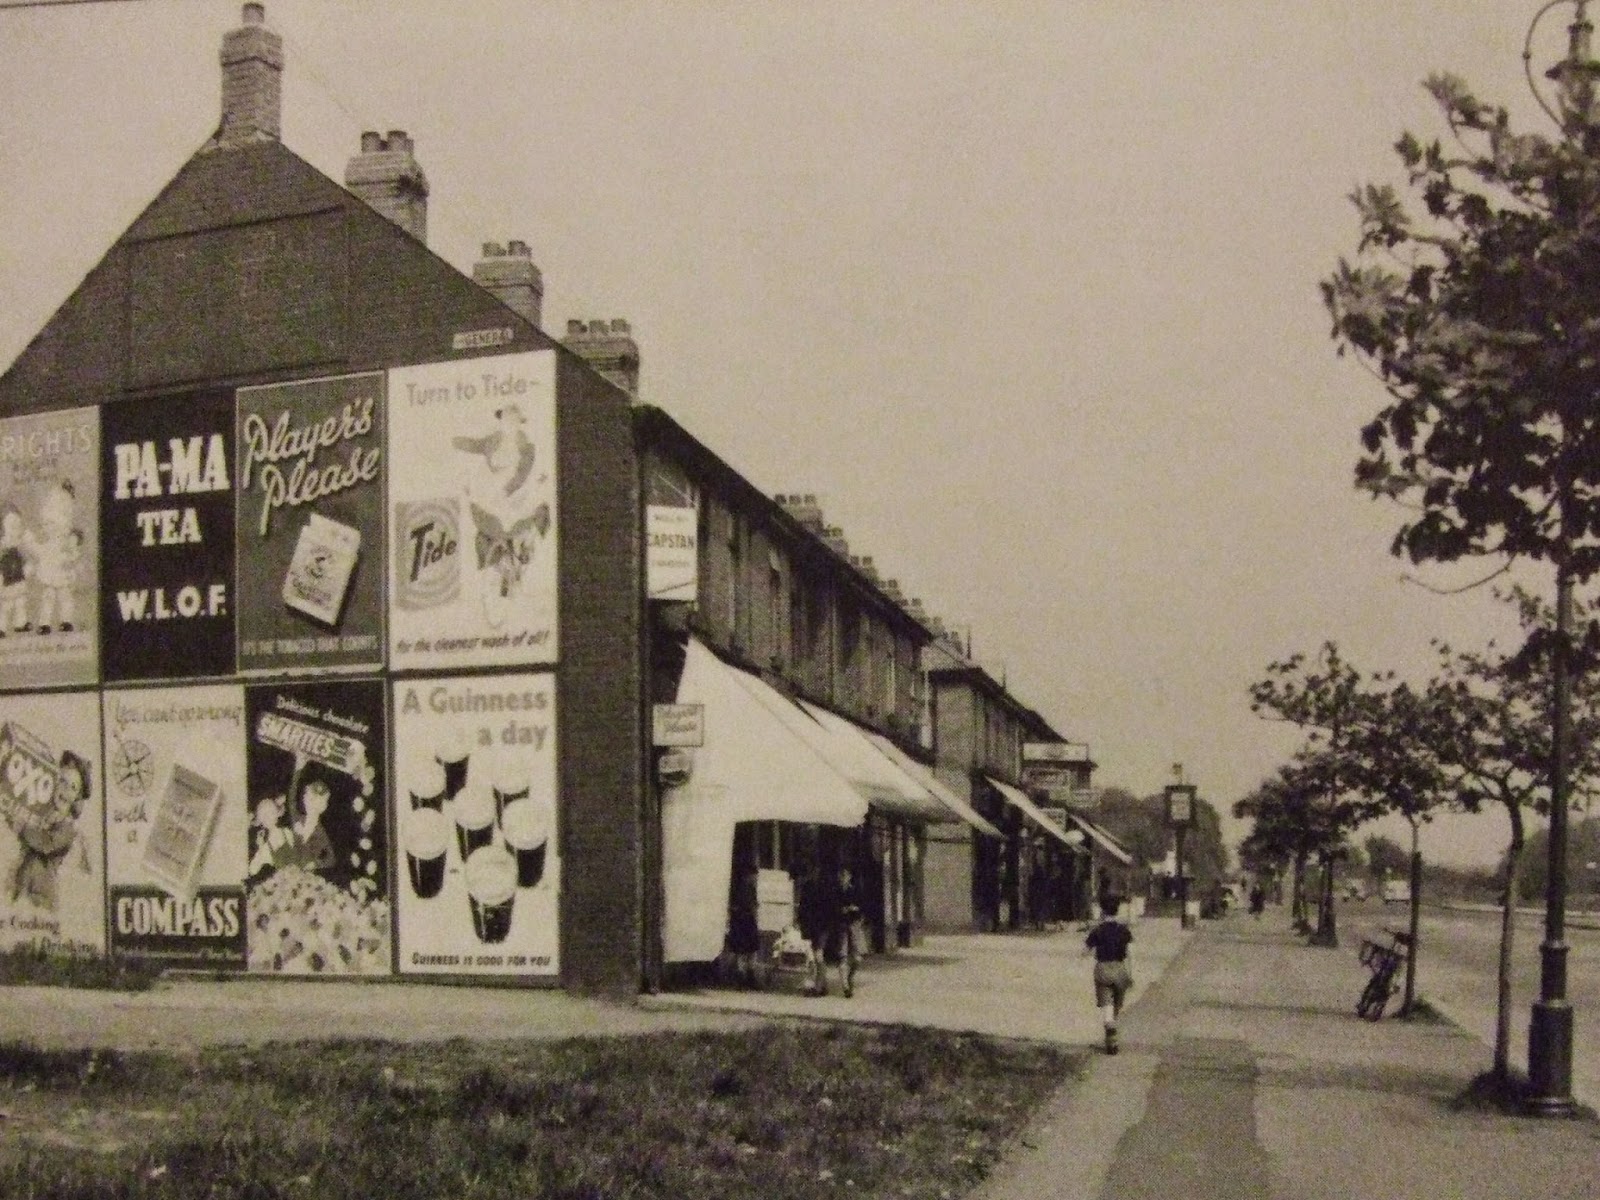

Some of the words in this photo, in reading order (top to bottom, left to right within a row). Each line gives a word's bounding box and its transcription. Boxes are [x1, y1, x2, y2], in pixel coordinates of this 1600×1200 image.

[406, 383, 449, 407] Turn
[455, 382, 477, 400] to
[243, 398, 374, 489] Player's
[114, 433, 230, 500] PA-MA
[260, 447, 381, 535] Please
[137, 508, 202, 547] TEA
[410, 522, 457, 582] Tide
[117, 584, 227, 622] W.L.O.F.
[402, 687, 421, 714] A
[429, 686, 548, 715] Guinness
[259, 713, 336, 758] SMARTIES
[477, 727, 493, 746] a
[501, 719, 548, 752] day
[7, 751, 54, 804] OXO
[117, 896, 240, 937] COMPASS
